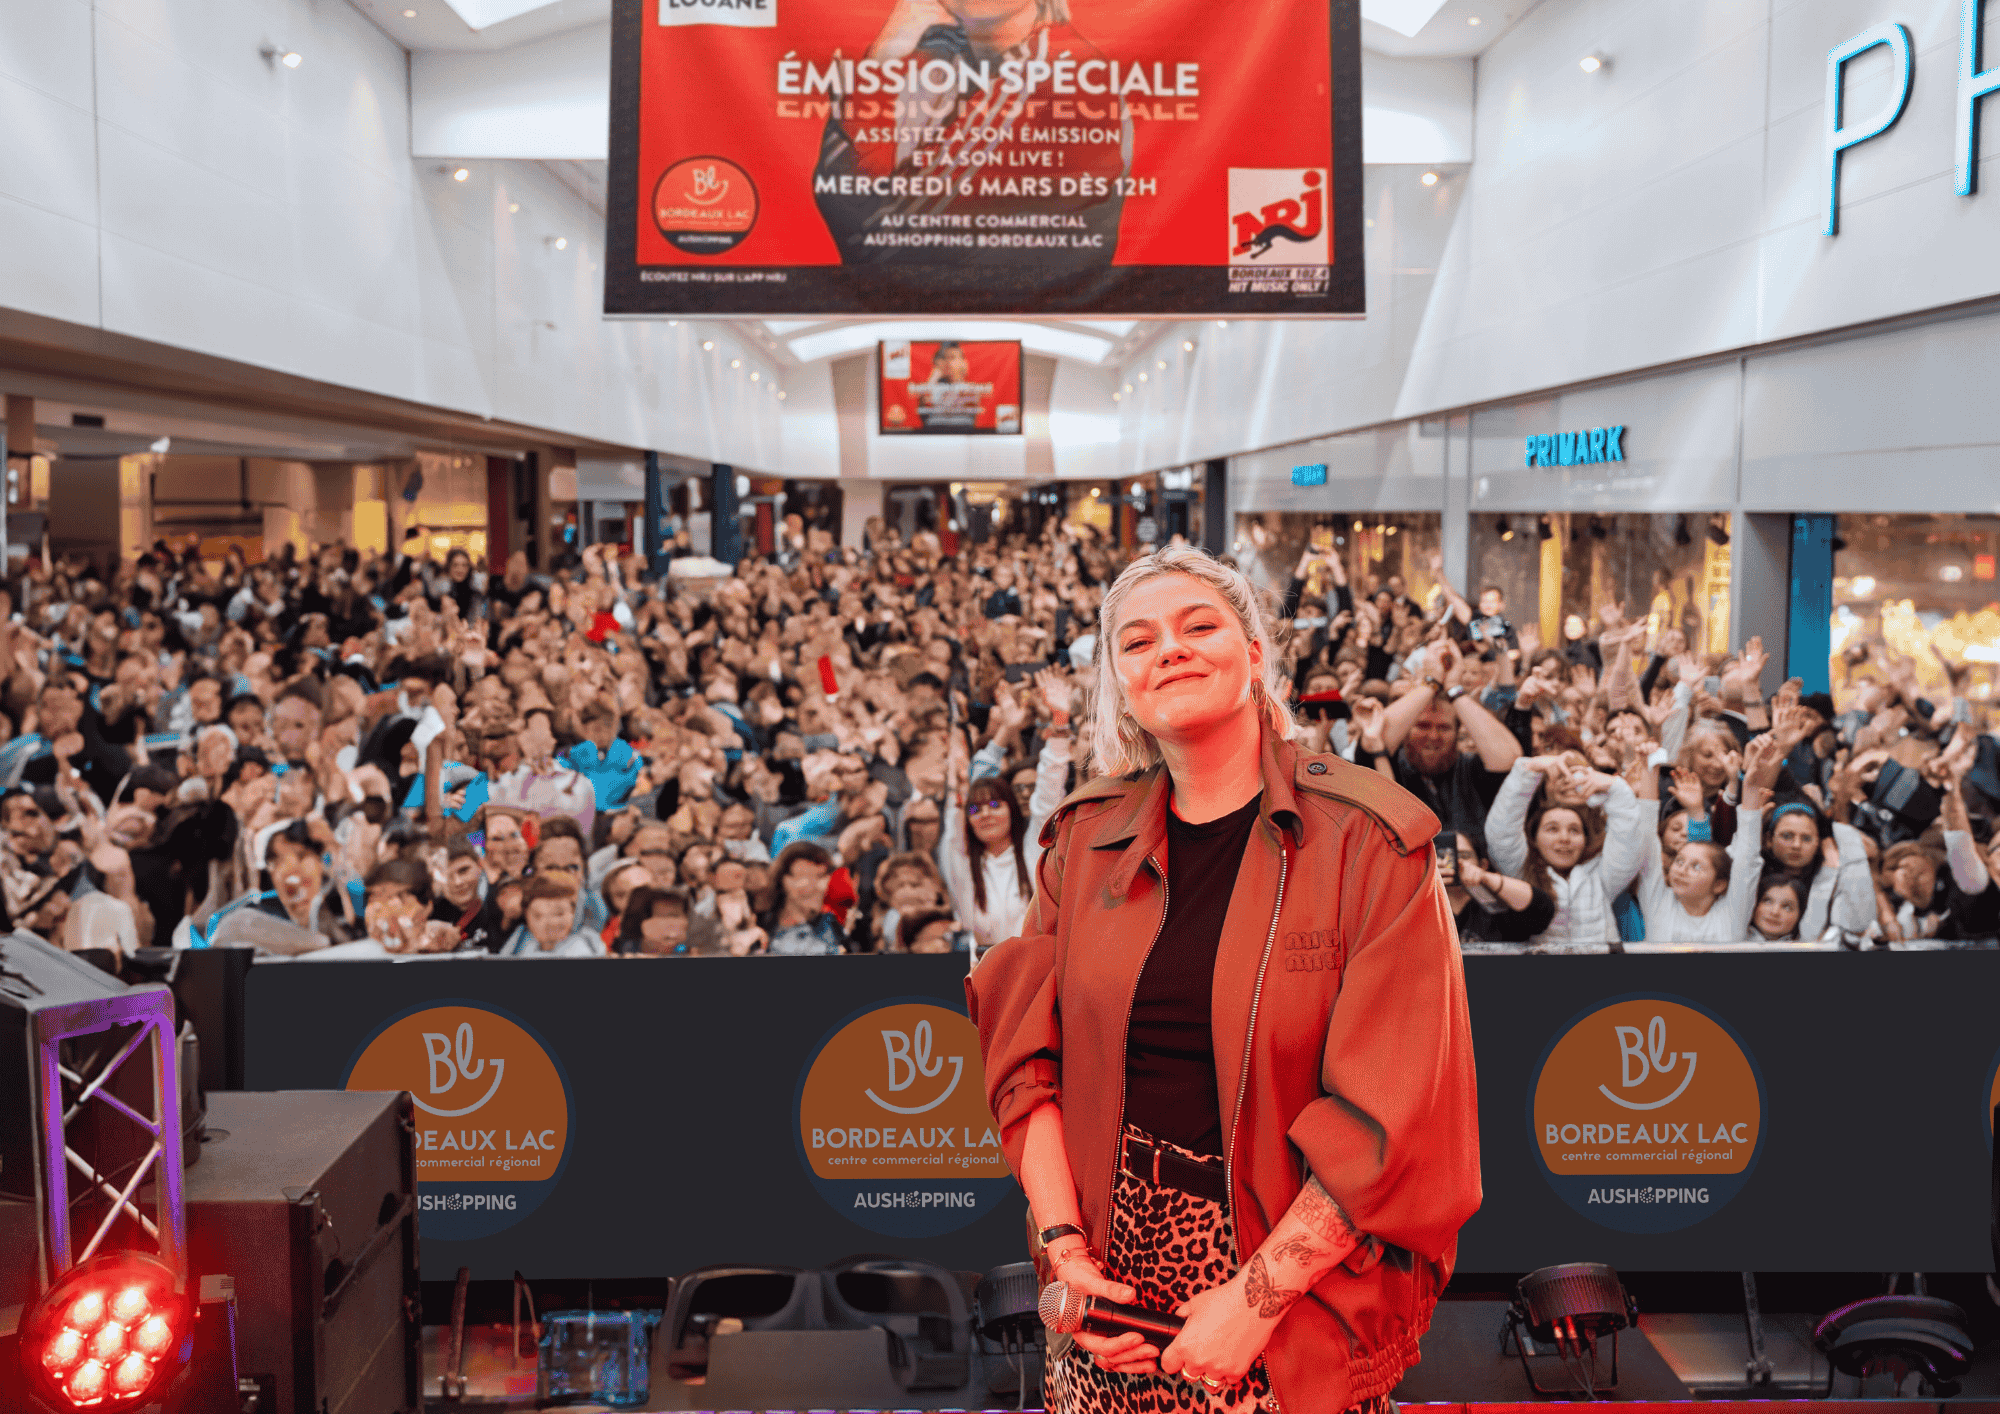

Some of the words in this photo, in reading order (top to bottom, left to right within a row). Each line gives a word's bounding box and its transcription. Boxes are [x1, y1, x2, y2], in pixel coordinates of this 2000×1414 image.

[777, 51, 990, 94] ÉMISSION
[1000, 51, 1199, 96] SPÉCIALE
[855, 127, 947, 143] ASSISTEZ
[951, 122, 966, 143] À
[970, 127, 1014, 143] SON
[1020, 123, 1120, 144] ÉMISSION
[912, 150, 935, 166] ET
[939, 146, 954, 166] À
[959, 150, 1003, 167] SON
[1009, 151, 1052, 167] LIVE
[815, 175, 952, 196] MERCREDI
[959, 177, 974, 196] 6
[980, 177, 1053, 197] MARS
[1060, 171, 1109, 197] DÈS
[1114, 177, 1157, 197] 12H
[880, 214, 905, 228] AU
[907, 214, 971, 228] CENTRE
[974, 214, 1087, 228] COMMERCIAL
[864, 233, 974, 247] AUSHOPPING
[977, 233, 1068, 247] BORDEAUX
[1071, 233, 1103, 248] LAC
[1525, 425, 1624, 467] PRIMARK
[505, 1130, 555, 1150] LAC
[812, 1127, 955, 1148] BORDEAUX
[965, 1127, 1002, 1148] LA
[1546, 1123, 1689, 1144] BORDEAUX
[1698, 1122, 1748, 1143] LAC
[489, 1155, 540, 1171] régional
[828, 1155, 867, 1165] centre
[872, 1153, 943, 1165] commercial
[948, 1153, 999, 1168] régional
[1562, 1151, 1601, 1161] centre
[1606, 1149, 1677, 1161] commercial
[1682, 1149, 1733, 1164] régional
